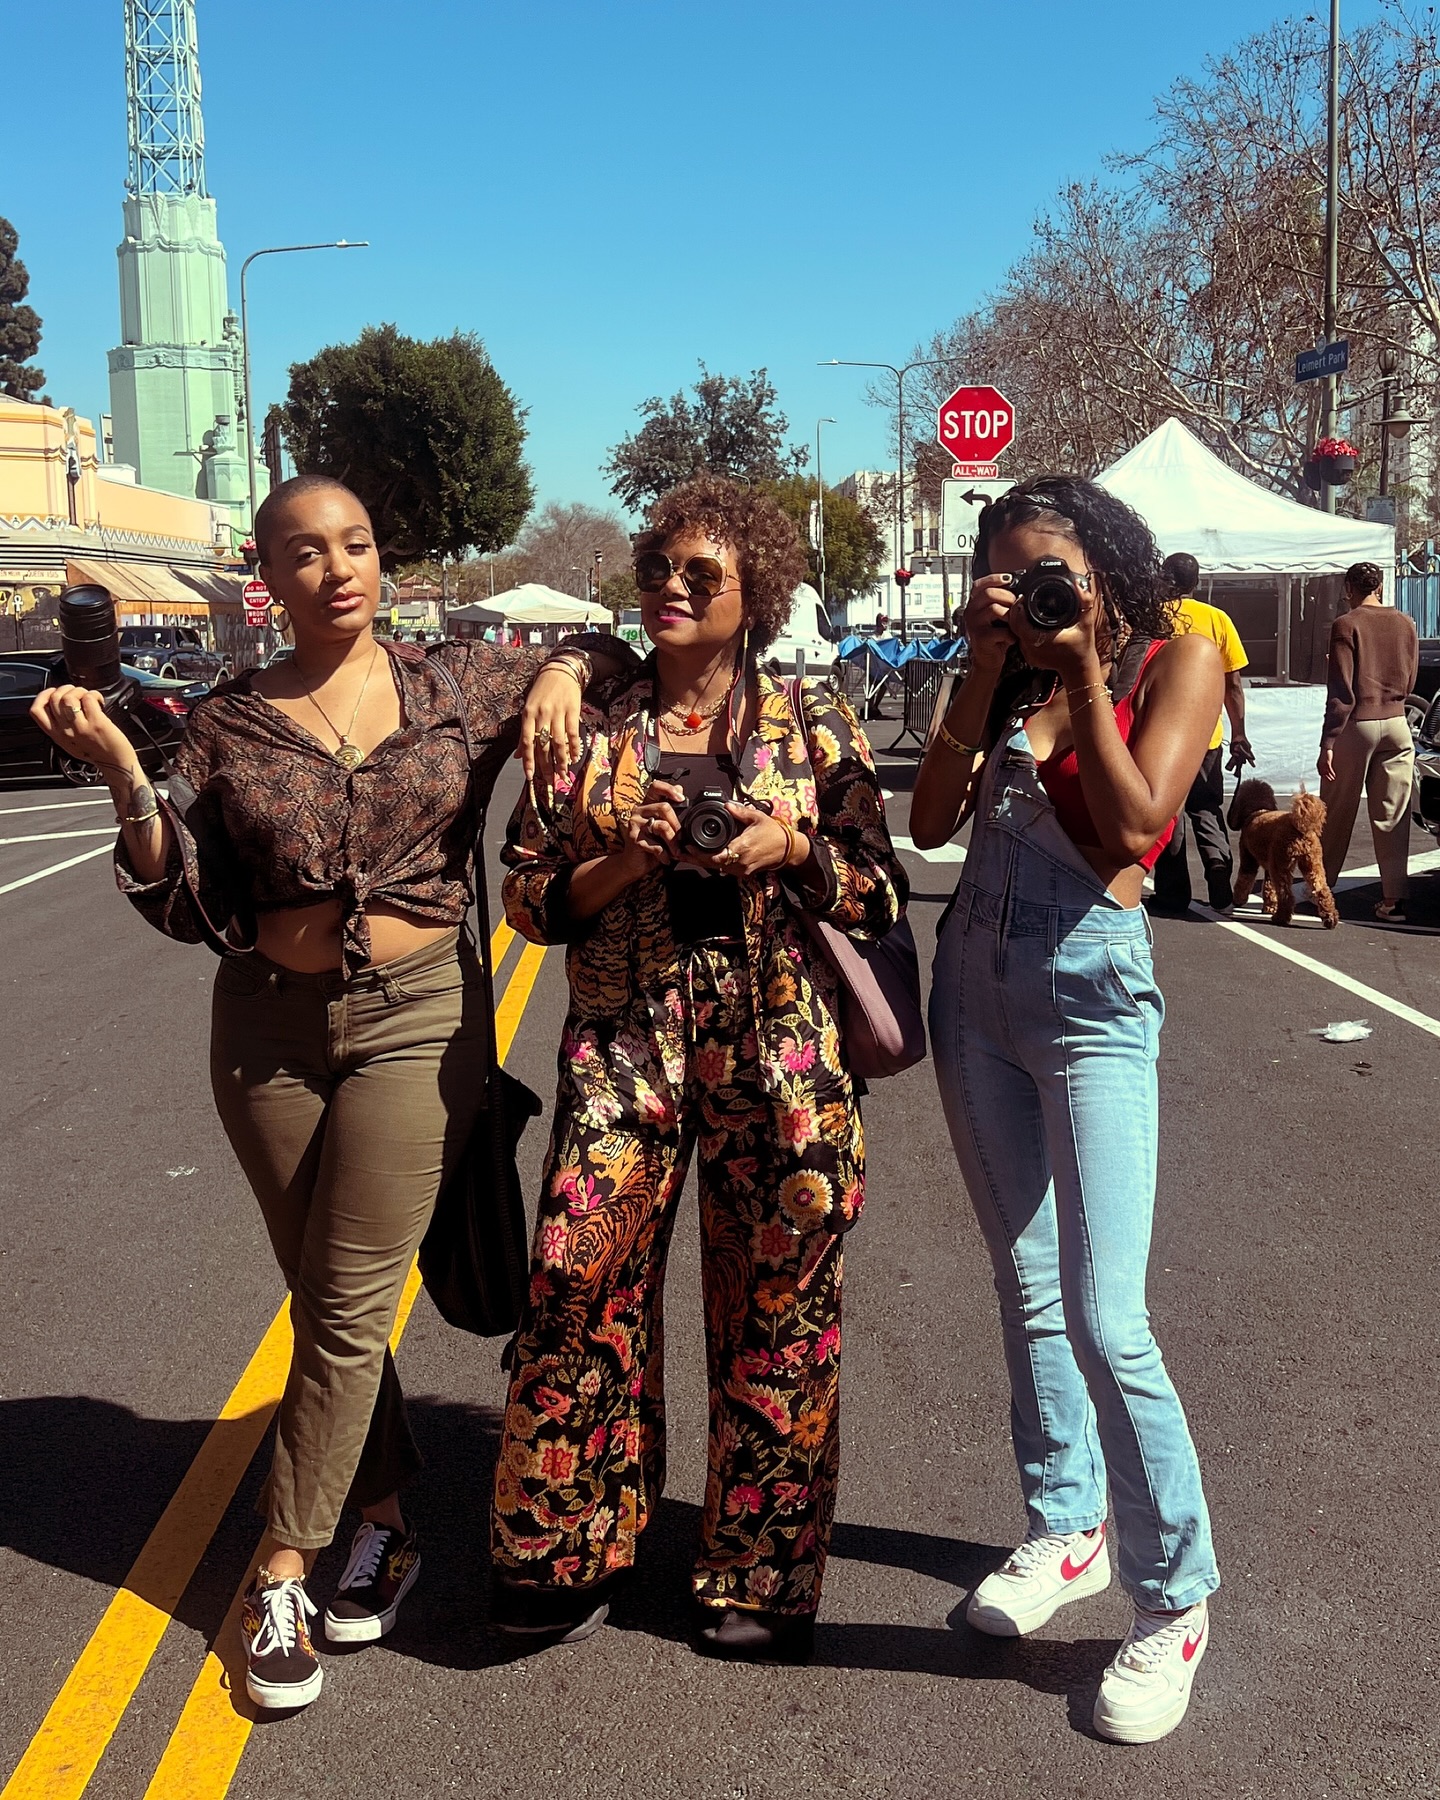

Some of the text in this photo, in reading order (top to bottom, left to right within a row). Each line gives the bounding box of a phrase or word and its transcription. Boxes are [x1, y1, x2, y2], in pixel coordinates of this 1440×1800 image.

[1297, 350, 1346, 374] Leimert Park
[943, 410, 1009, 439] STOP
[954, 466, 996, 477] ALL-WAY
[957, 534, 976, 549] ON
